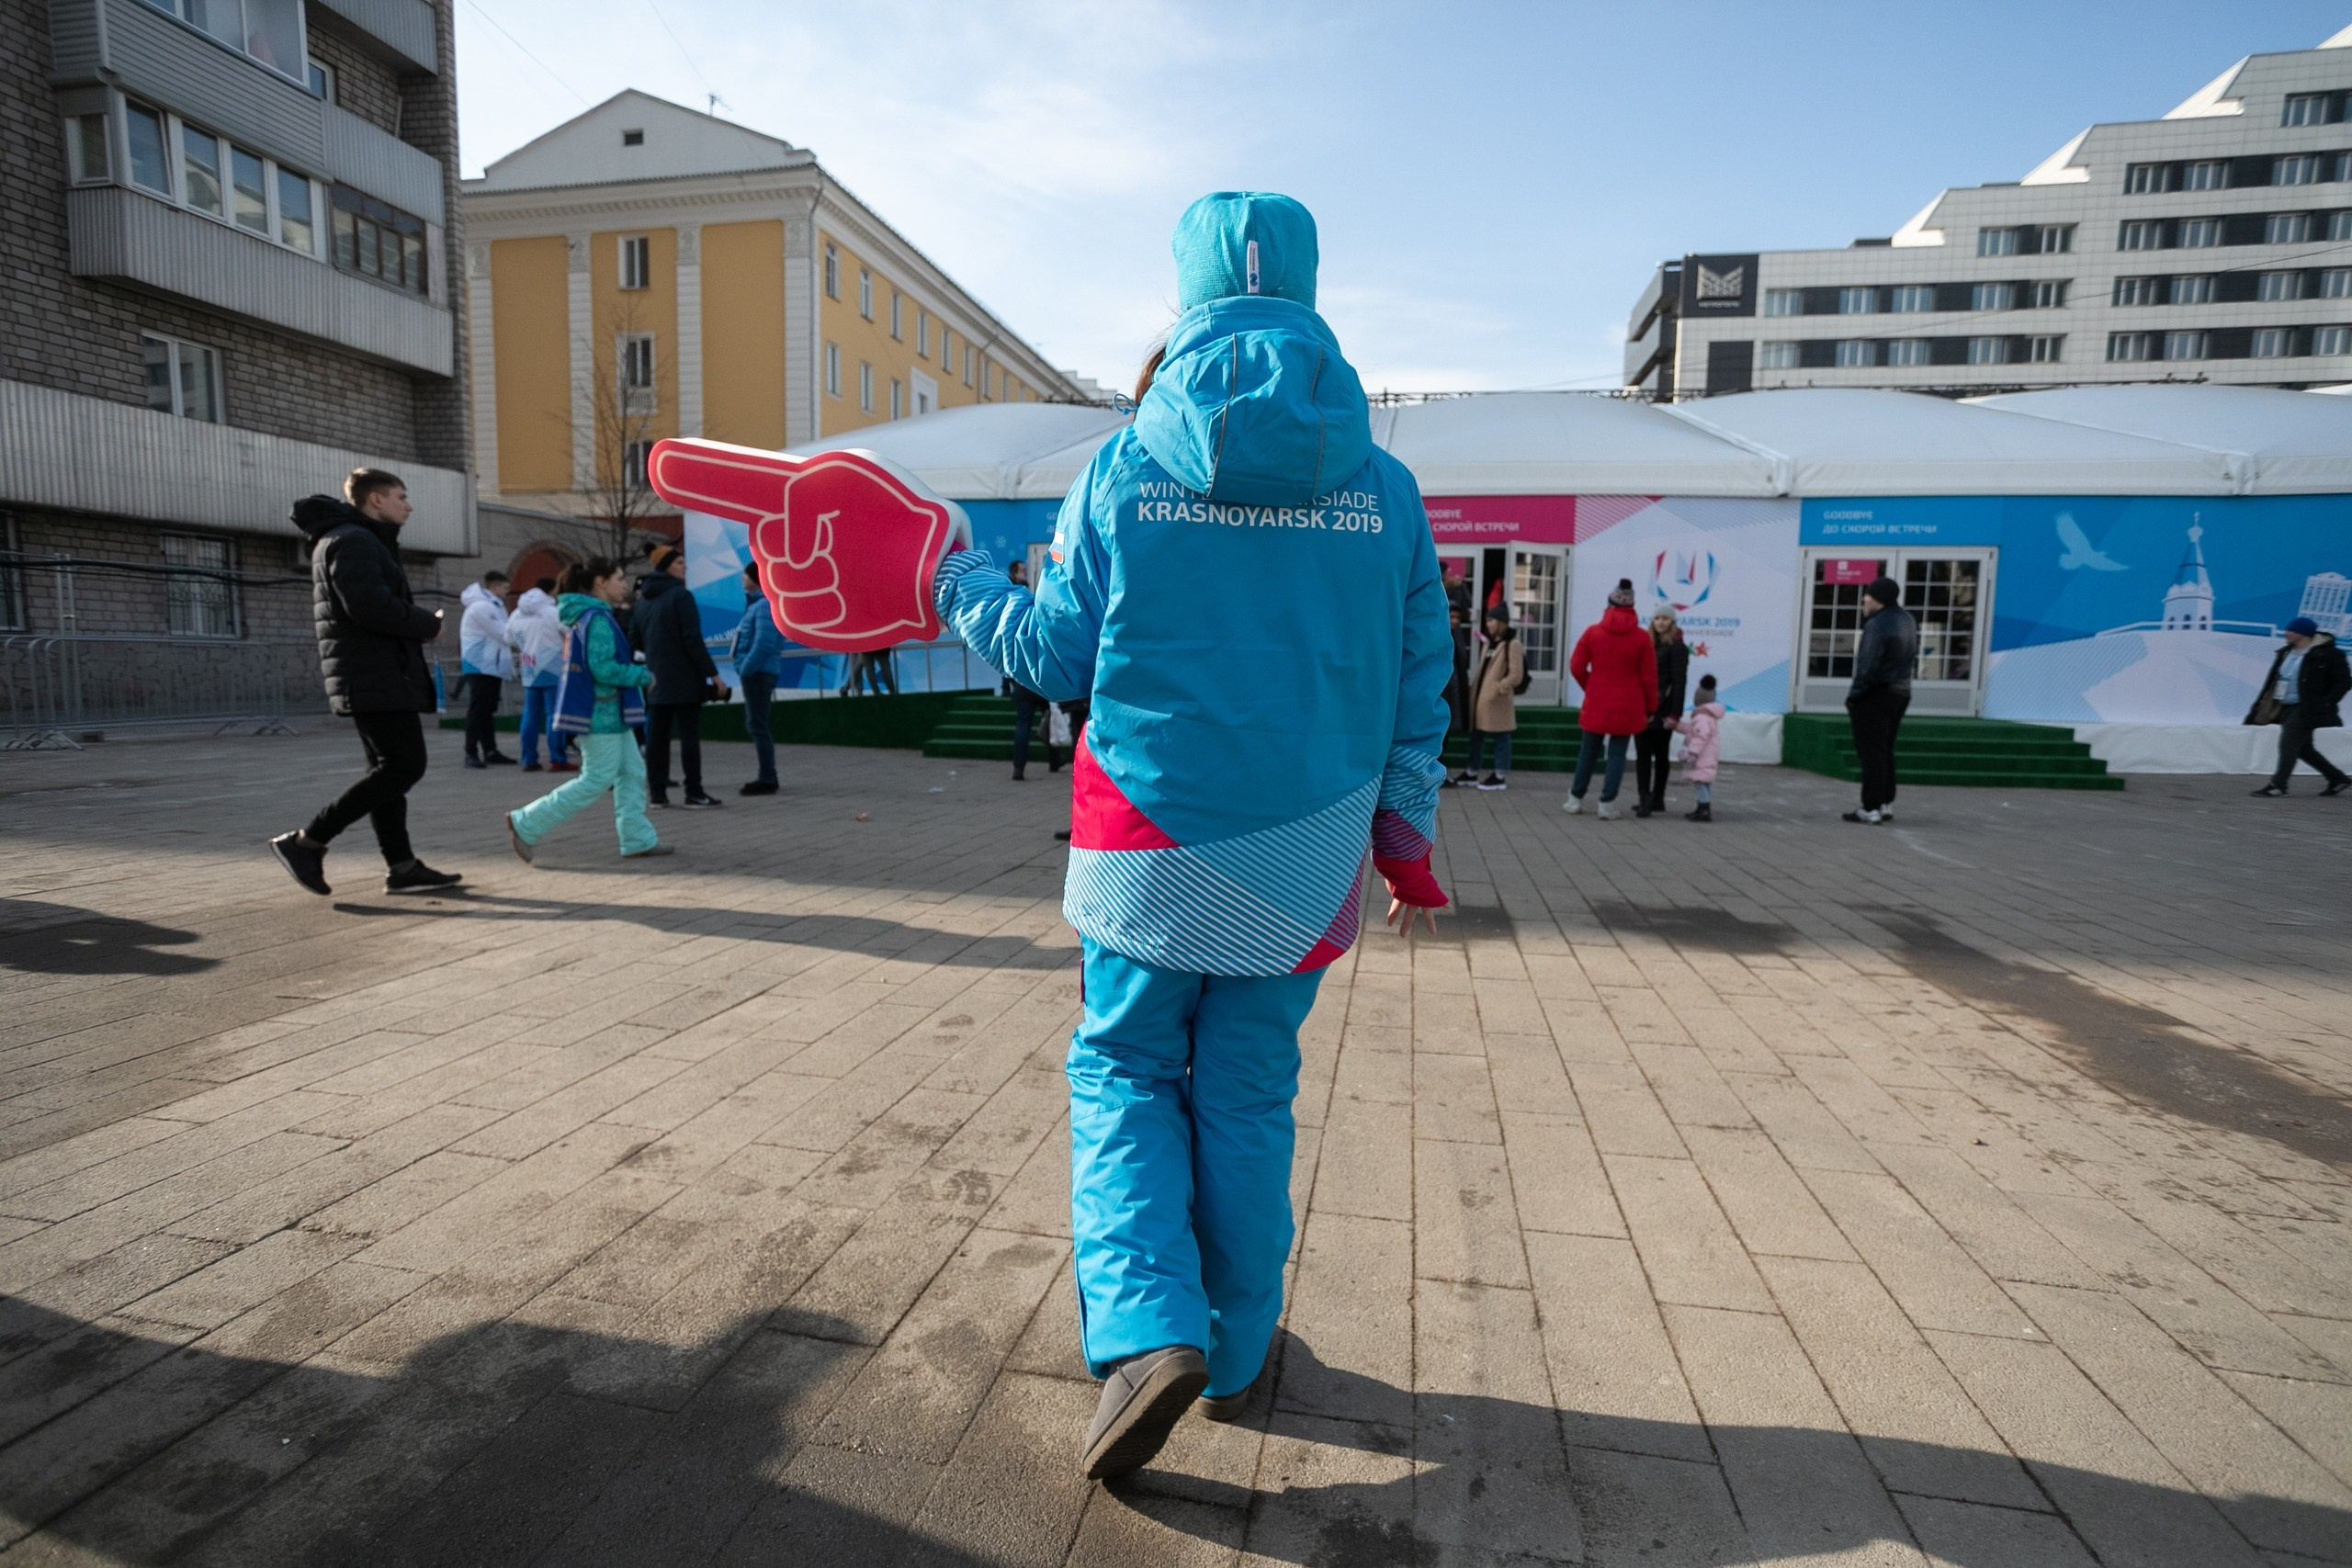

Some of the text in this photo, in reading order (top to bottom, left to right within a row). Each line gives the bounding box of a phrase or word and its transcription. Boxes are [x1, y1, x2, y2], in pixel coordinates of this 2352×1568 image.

[1137, 502, 1384, 534] KRASNOYARSK 2019
[1474, 522, 1520, 532] ВСТРЕЧИ
